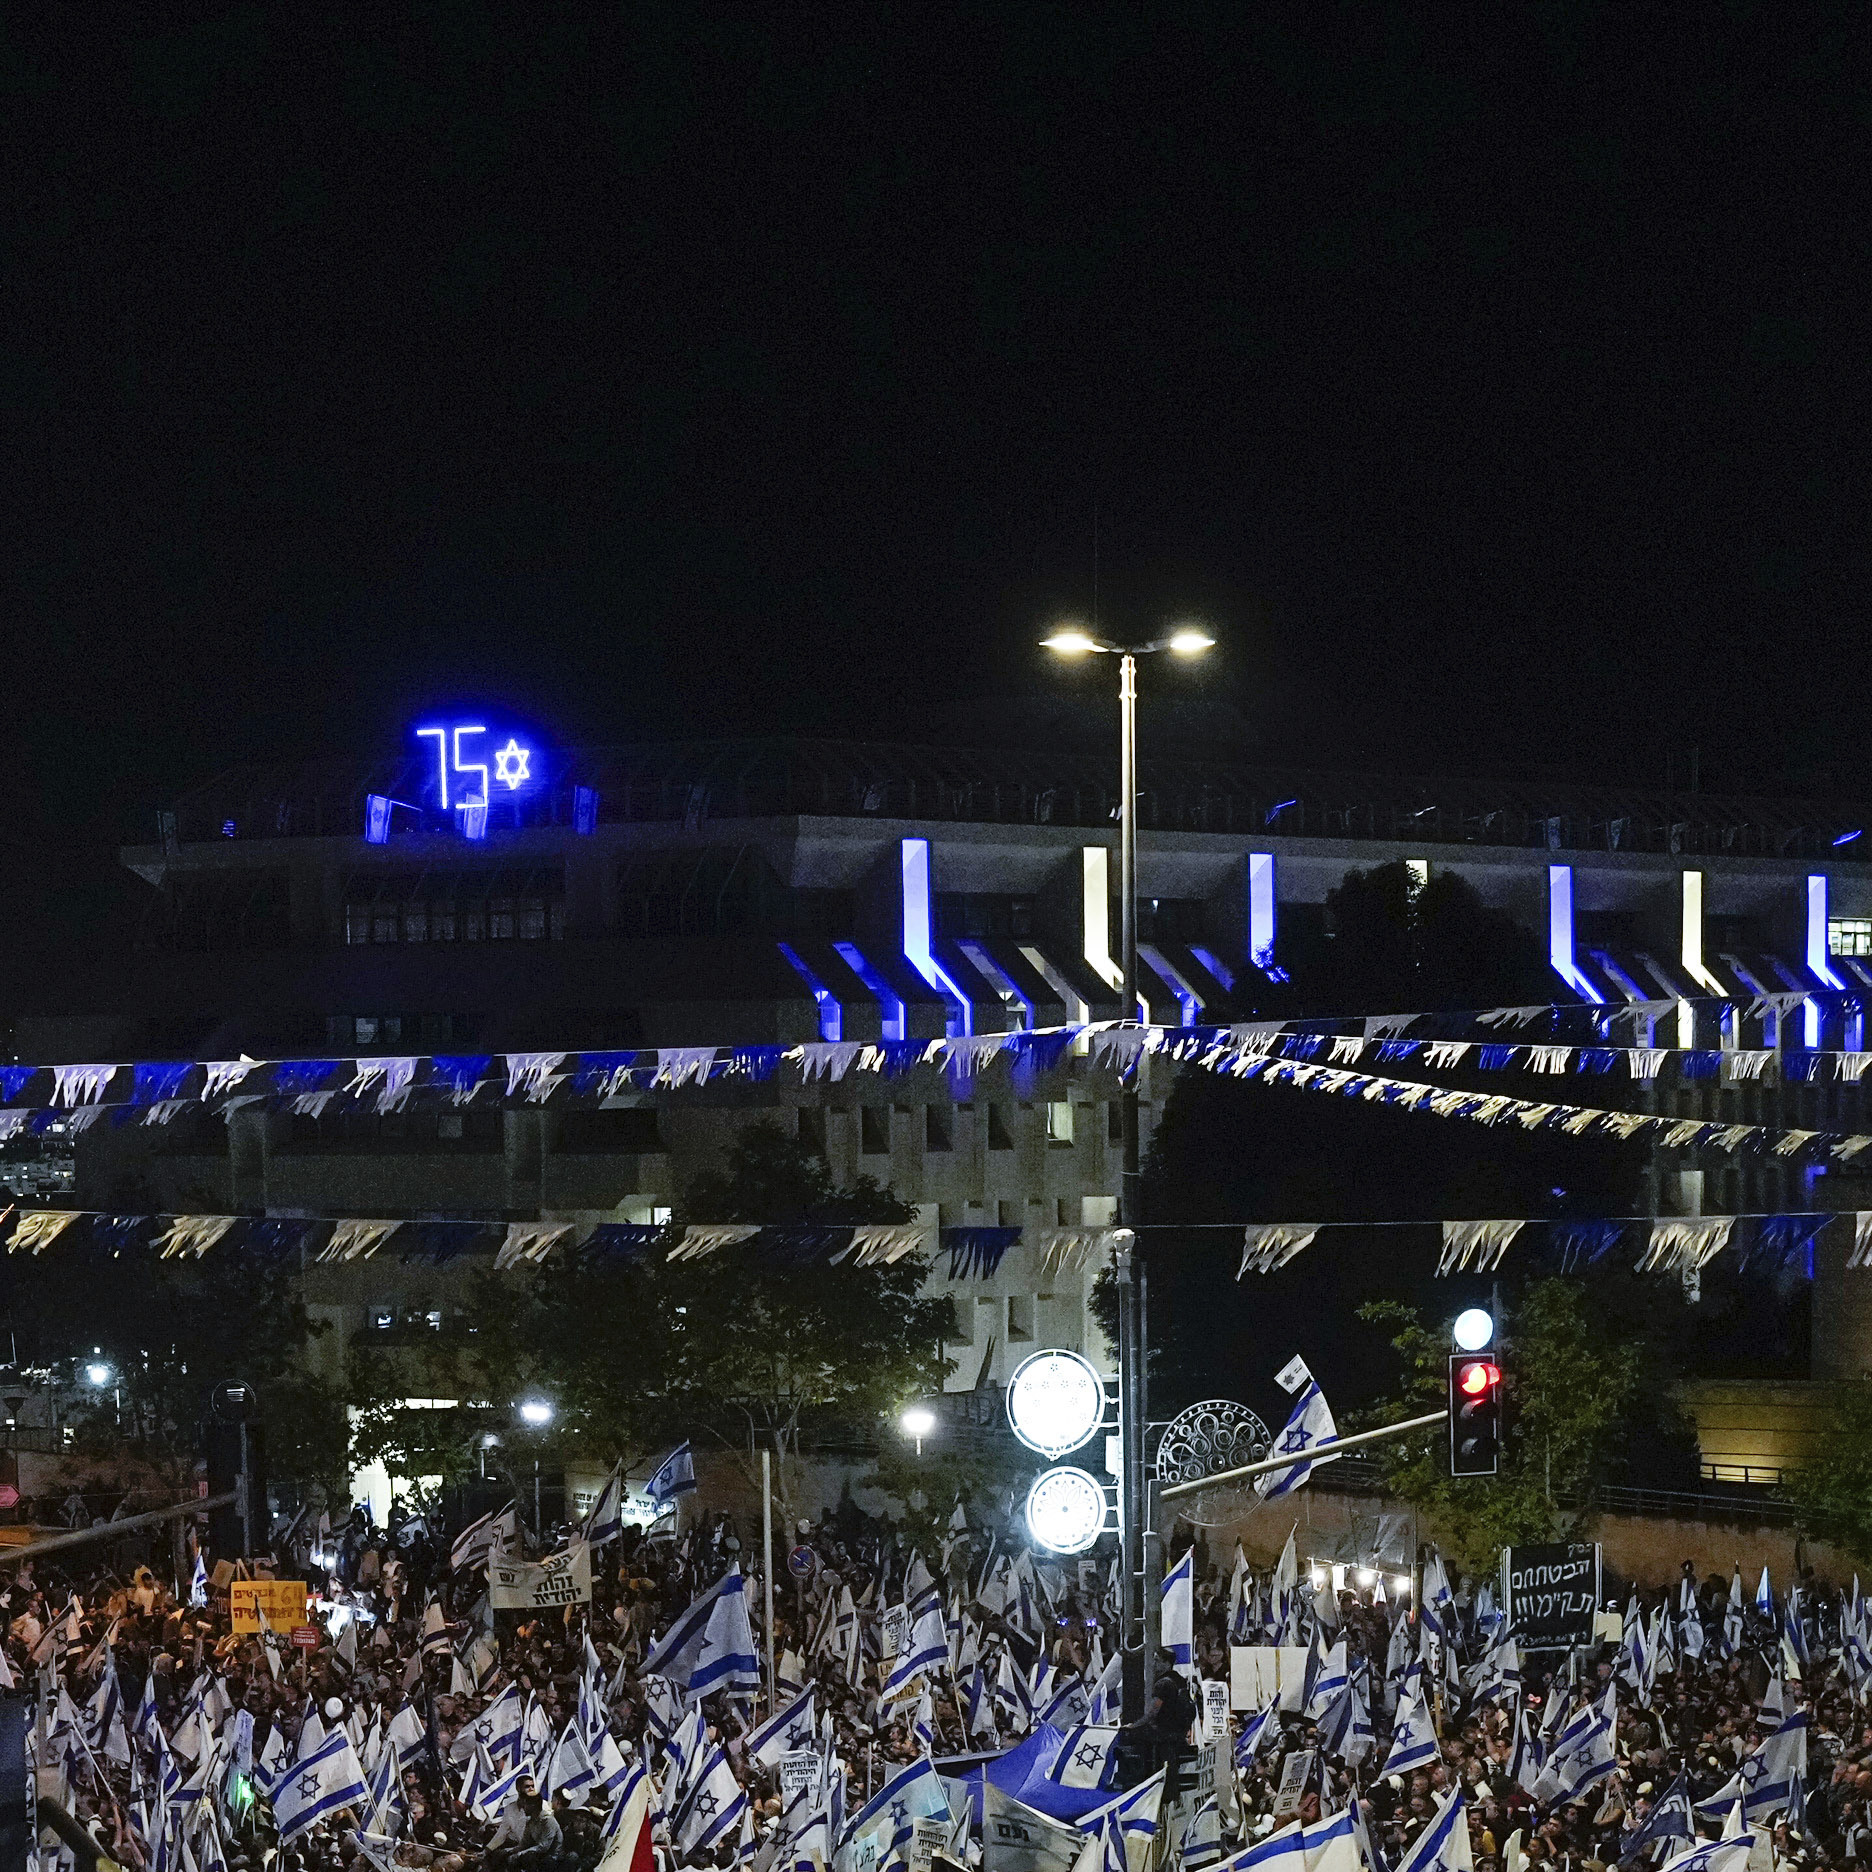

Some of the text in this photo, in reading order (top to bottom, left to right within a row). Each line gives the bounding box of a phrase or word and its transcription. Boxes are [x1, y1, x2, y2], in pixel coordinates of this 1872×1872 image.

[416, 725, 489, 810] 75
[532, 1587, 581, 1605] יהודית
[786, 1768, 816, 1776] היהודית
